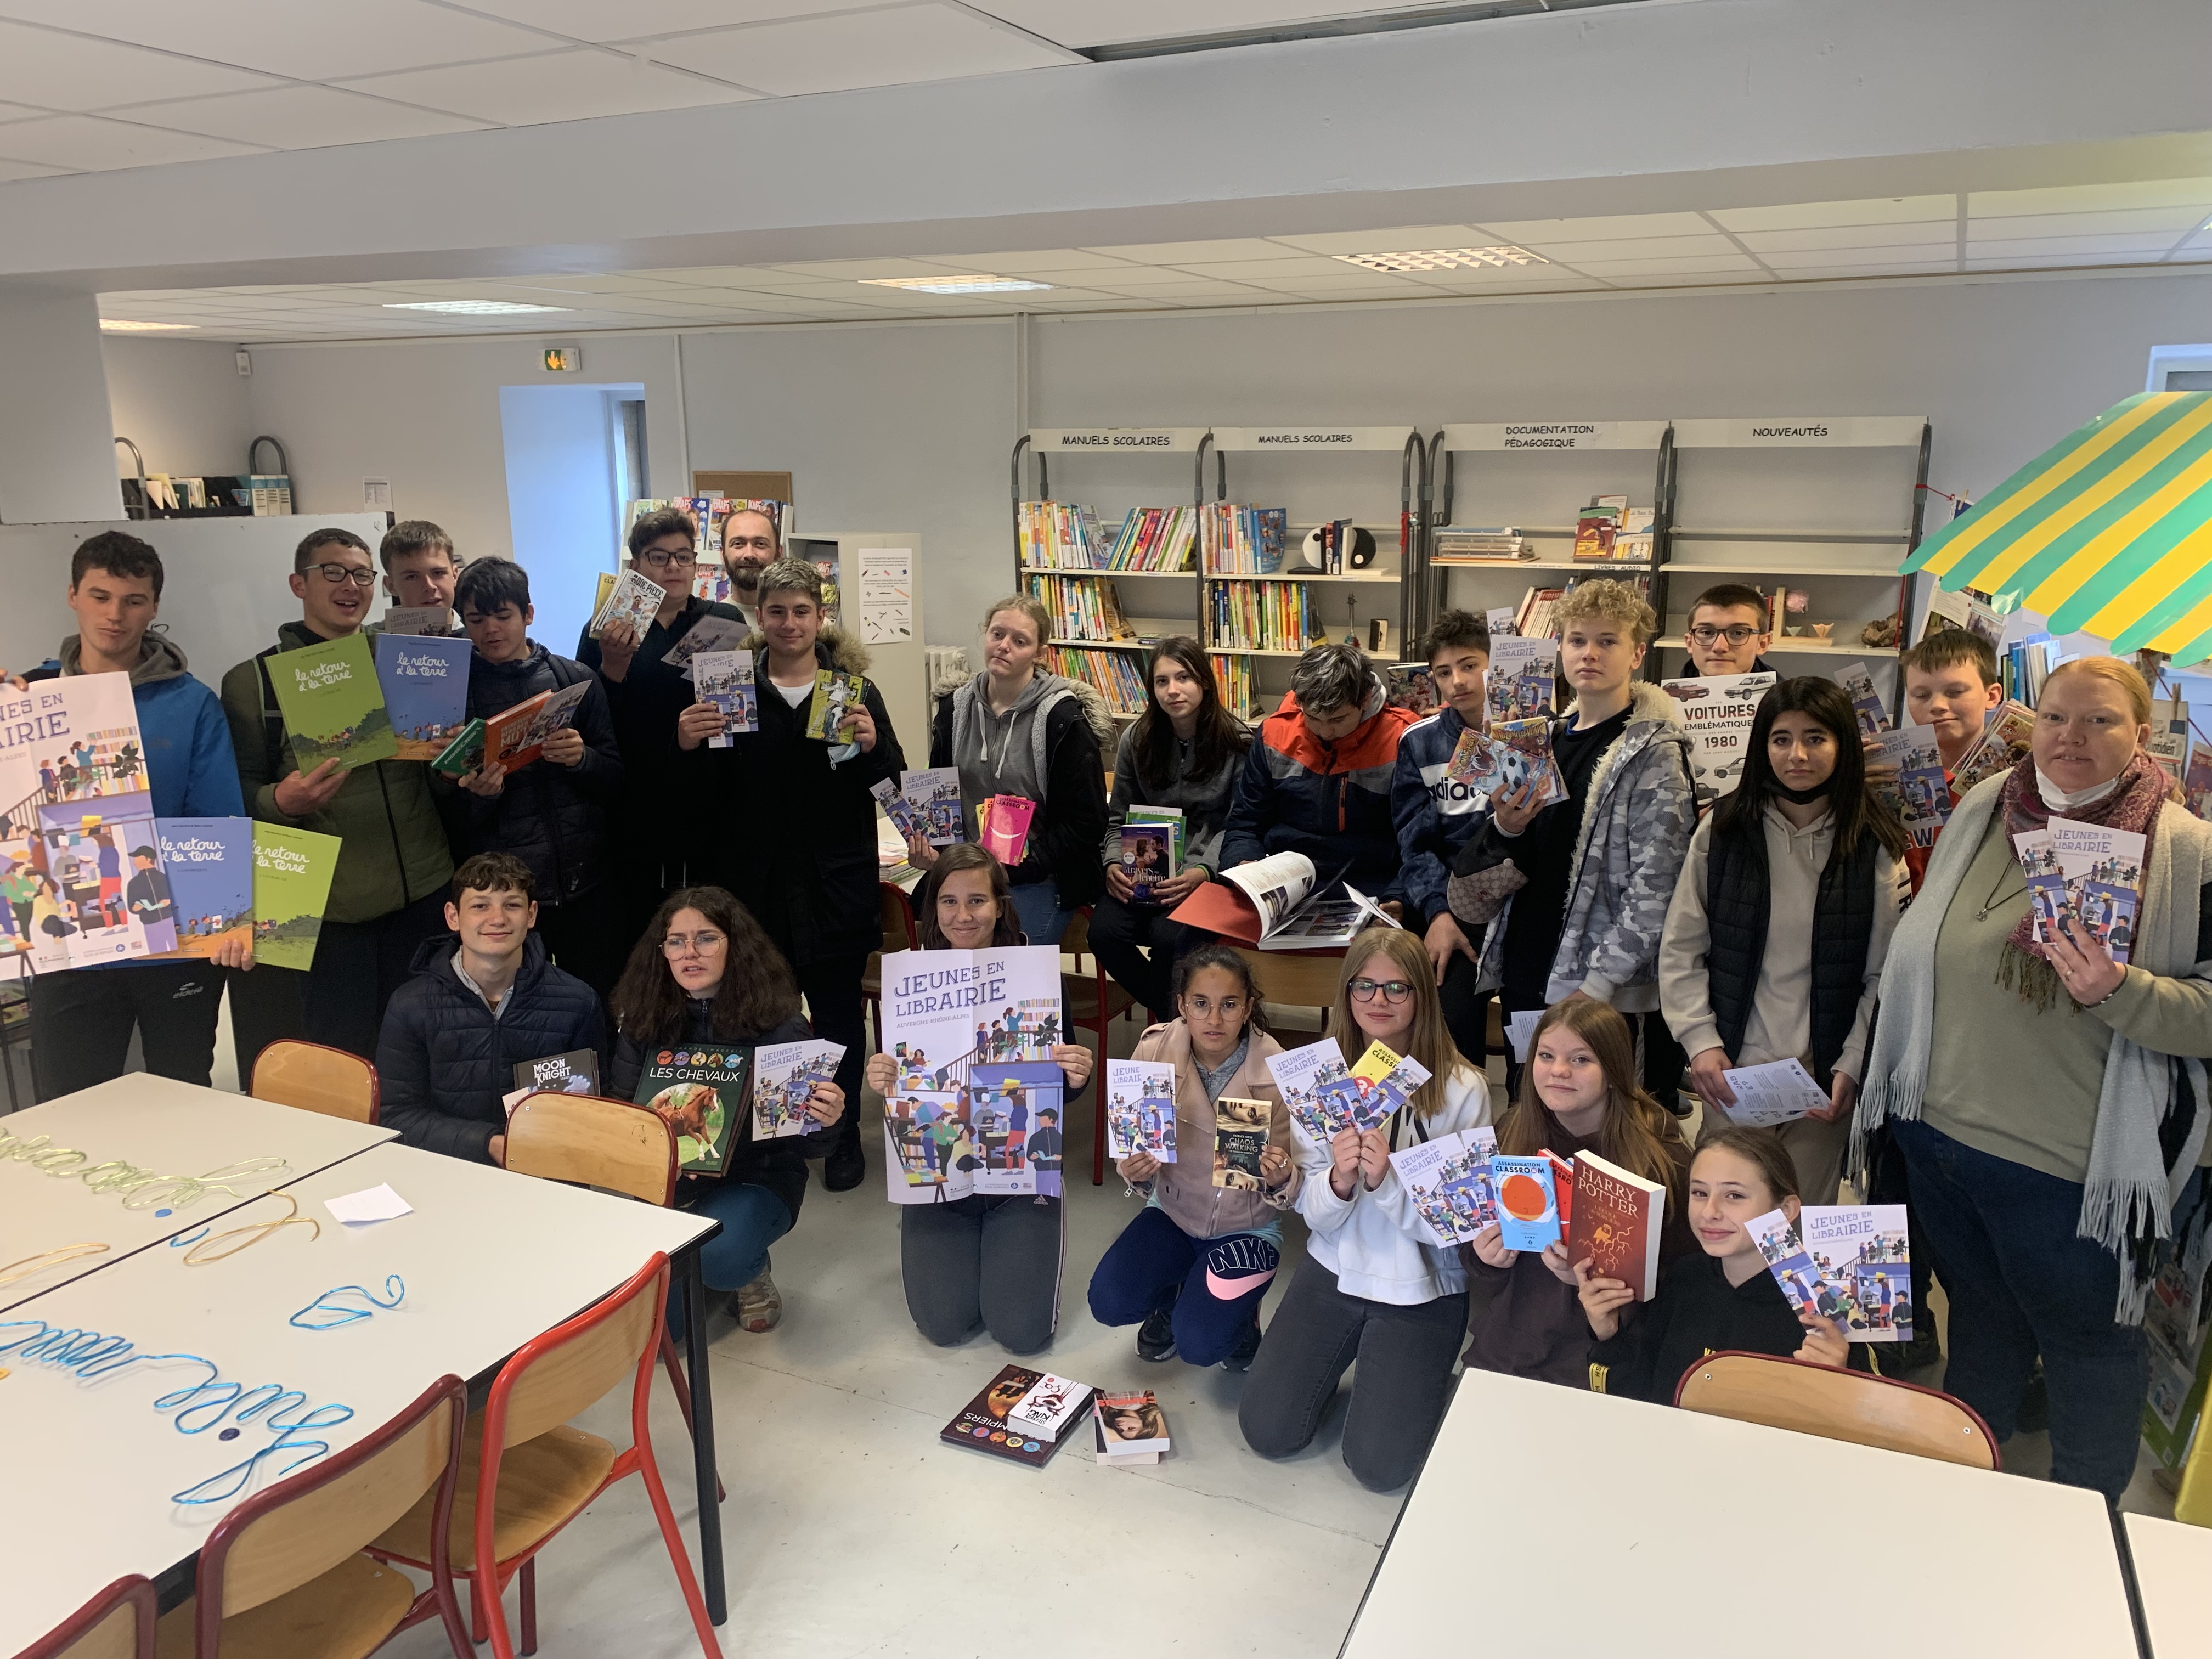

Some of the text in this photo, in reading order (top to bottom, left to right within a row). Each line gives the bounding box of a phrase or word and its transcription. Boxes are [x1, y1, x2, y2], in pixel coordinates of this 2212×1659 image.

[1505, 425, 1594, 435] DOCUMENTATION
[1753, 425, 1829, 437] NOUVEAUTÉS
[1062, 436, 1170, 446] MANUELS SCOLAIRES
[1258, 434, 1353, 443] MANUELS SCOLAIRES
[1504, 436, 1576, 448] PÉDAGOGIQUE
[391, 611, 419, 622] JEUNES
[391, 616, 428, 628] LIBRAIRIE
[1496, 642, 1528, 651] JEUNES
[1496, 647, 1536, 657] LIBRAIRIE
[397, 652, 449, 667] le retour
[698, 655, 725, 668] JEUNES
[295, 661, 351, 681] le retour
[405, 665, 418, 675] la
[420, 667, 448, 677] terre
[308, 678, 322, 689] la
[321, 669, 352, 684] terre
[41, 692, 64, 709] EN
[1684, 703, 1756, 721] VOITURES
[1705, 735, 1737, 748] 1980
[906, 772, 933, 784] JEUNES
[906, 776, 941, 790] LIBRAIRIE
[2054, 830, 2100, 840] JEUNES
[160, 836, 226, 851] le retour
[2053, 841, 2112, 854] LIBRAIRIE
[171, 850, 188, 862] la
[188, 850, 225, 862] terre
[264, 845, 311, 864] retour
[272, 859, 307, 874] terre
[894, 961, 1005, 998] JEUNES EN
[895, 978, 1006, 1017] LIBRAIRIE
[896, 1013, 970, 1029] AUVERGNE-RHÔNE-ALPES
[760, 1048, 793, 1063] JEUNES
[760, 1051, 803, 1070] LIBRAIRIE
[1276, 1048, 1315, 1072] JEUNES EN
[533, 1058, 566, 1079] MOON
[1279, 1054, 1319, 1079] LIBRAIRIE
[536, 1066, 571, 1087] KNIGHT
[649, 1066, 741, 1083] LES CHEVAUX
[1225, 1143, 1259, 1153] WALKING
[1229, 1137, 1255, 1146] CHAOS
[1400, 1148, 1429, 1170] JEUNES
[1403, 1150, 1443, 1177] LIBRAIRIE
[1496, 1166, 1545, 1174] CLASSROOM
[1583, 1165, 1637, 1203] HARRY
[1578, 1177, 1639, 1220] POTTER
[1810, 1212, 1858, 1229] JEUNES
[1812, 1220, 1874, 1239] LIBRAIRIE
[1208, 1238, 1275, 1273] NIKE
[1098, 1396, 1158, 1407] CAMPUS
[1024, 1414, 1047, 1425] STEPHEN
[1028, 1409, 1051, 1420] KING
